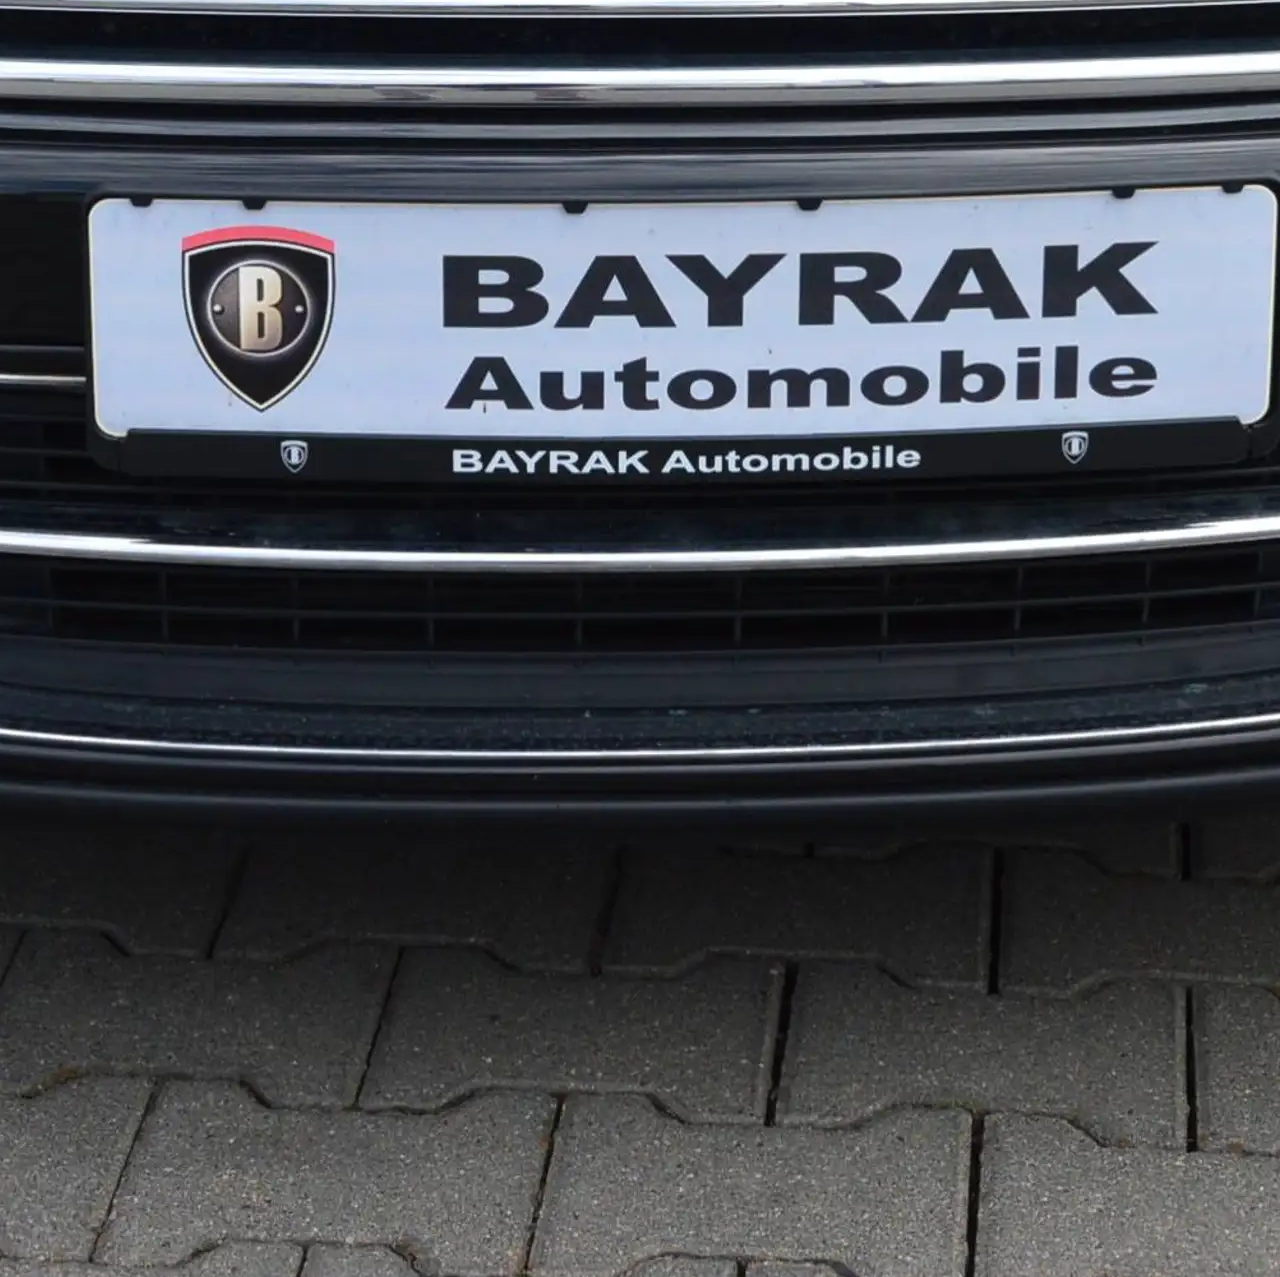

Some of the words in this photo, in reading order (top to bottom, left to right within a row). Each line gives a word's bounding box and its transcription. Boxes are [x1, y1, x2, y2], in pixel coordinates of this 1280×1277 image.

[238, 265, 283, 351] B
[442, 241, 1159, 328] BAYRAK
[444, 345, 1158, 411] Automobile
[452, 449, 650, 474] BAYRAK
[661, 445, 921, 474] Automobile
